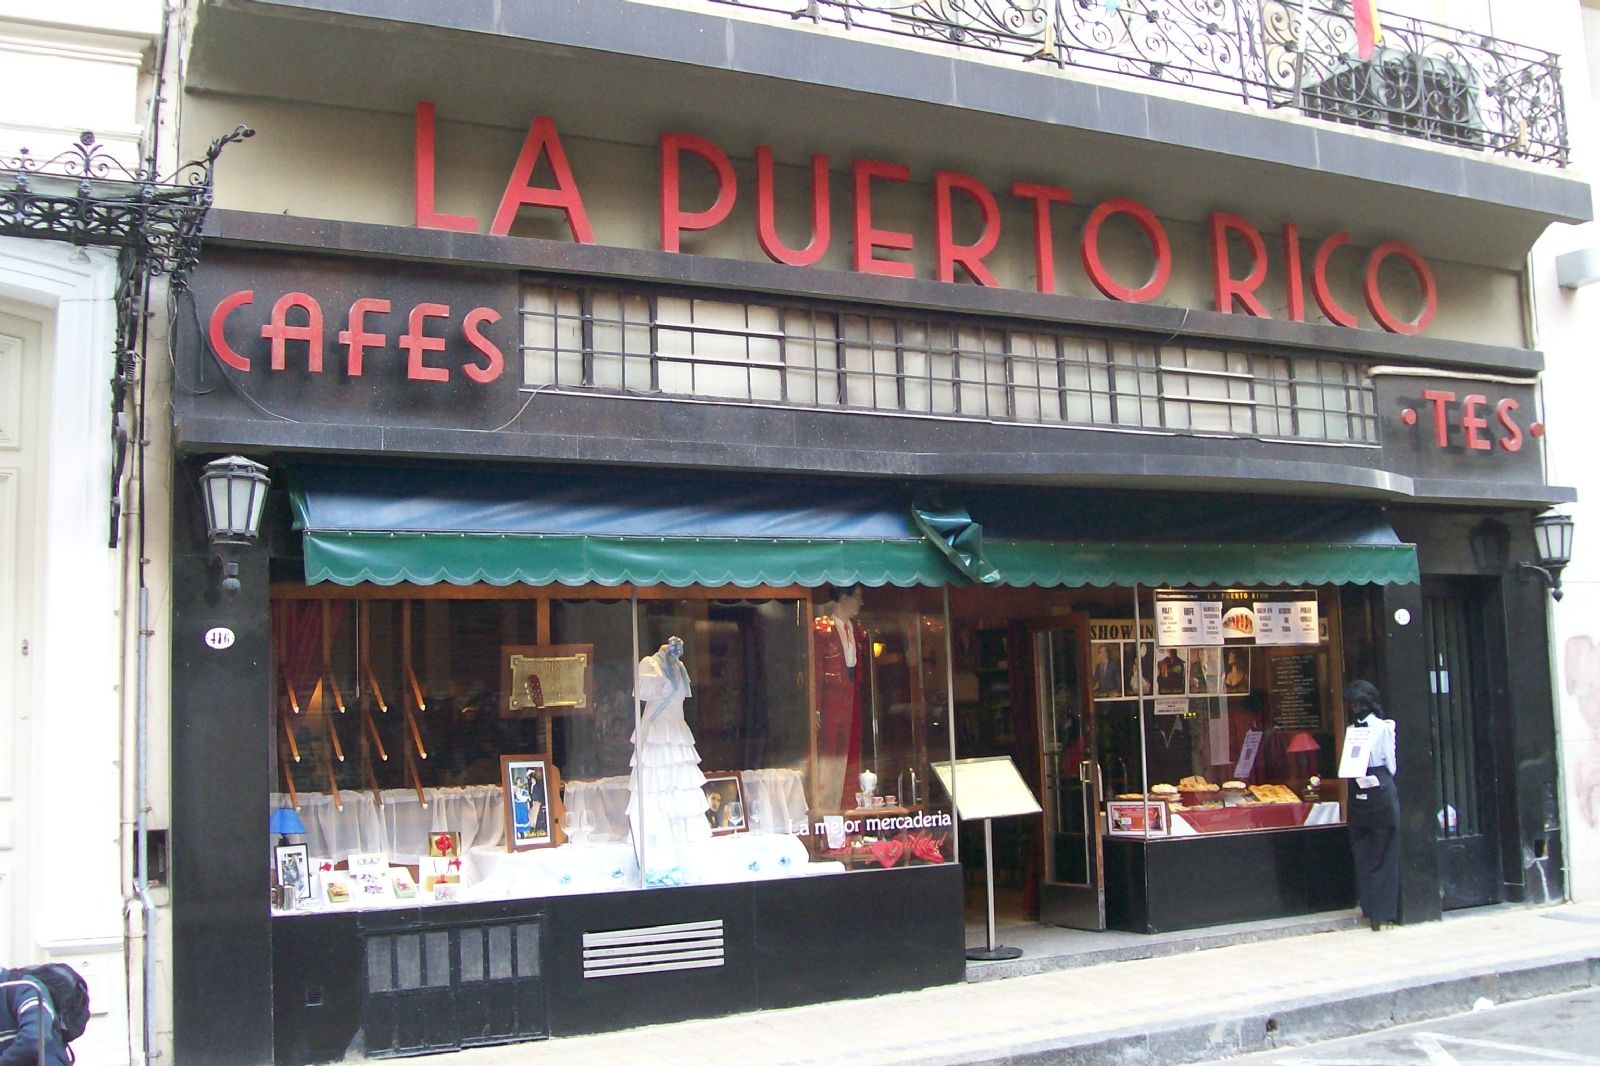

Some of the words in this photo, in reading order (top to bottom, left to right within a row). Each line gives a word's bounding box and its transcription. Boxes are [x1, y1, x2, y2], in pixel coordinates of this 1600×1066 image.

[415, 101, 595, 245] LA
[658, 132, 1172, 304] PUERTO
[1211, 211, 1438, 336] RICO
[209, 290, 504, 383] CAFES
[1421, 389, 1521, 453] TES
[1090, 624, 1133, 640] SHOW
[788, 819, 809, 836] La
[815, 820, 861, 836] mejor
[866, 809, 952, 832] mercaderia
